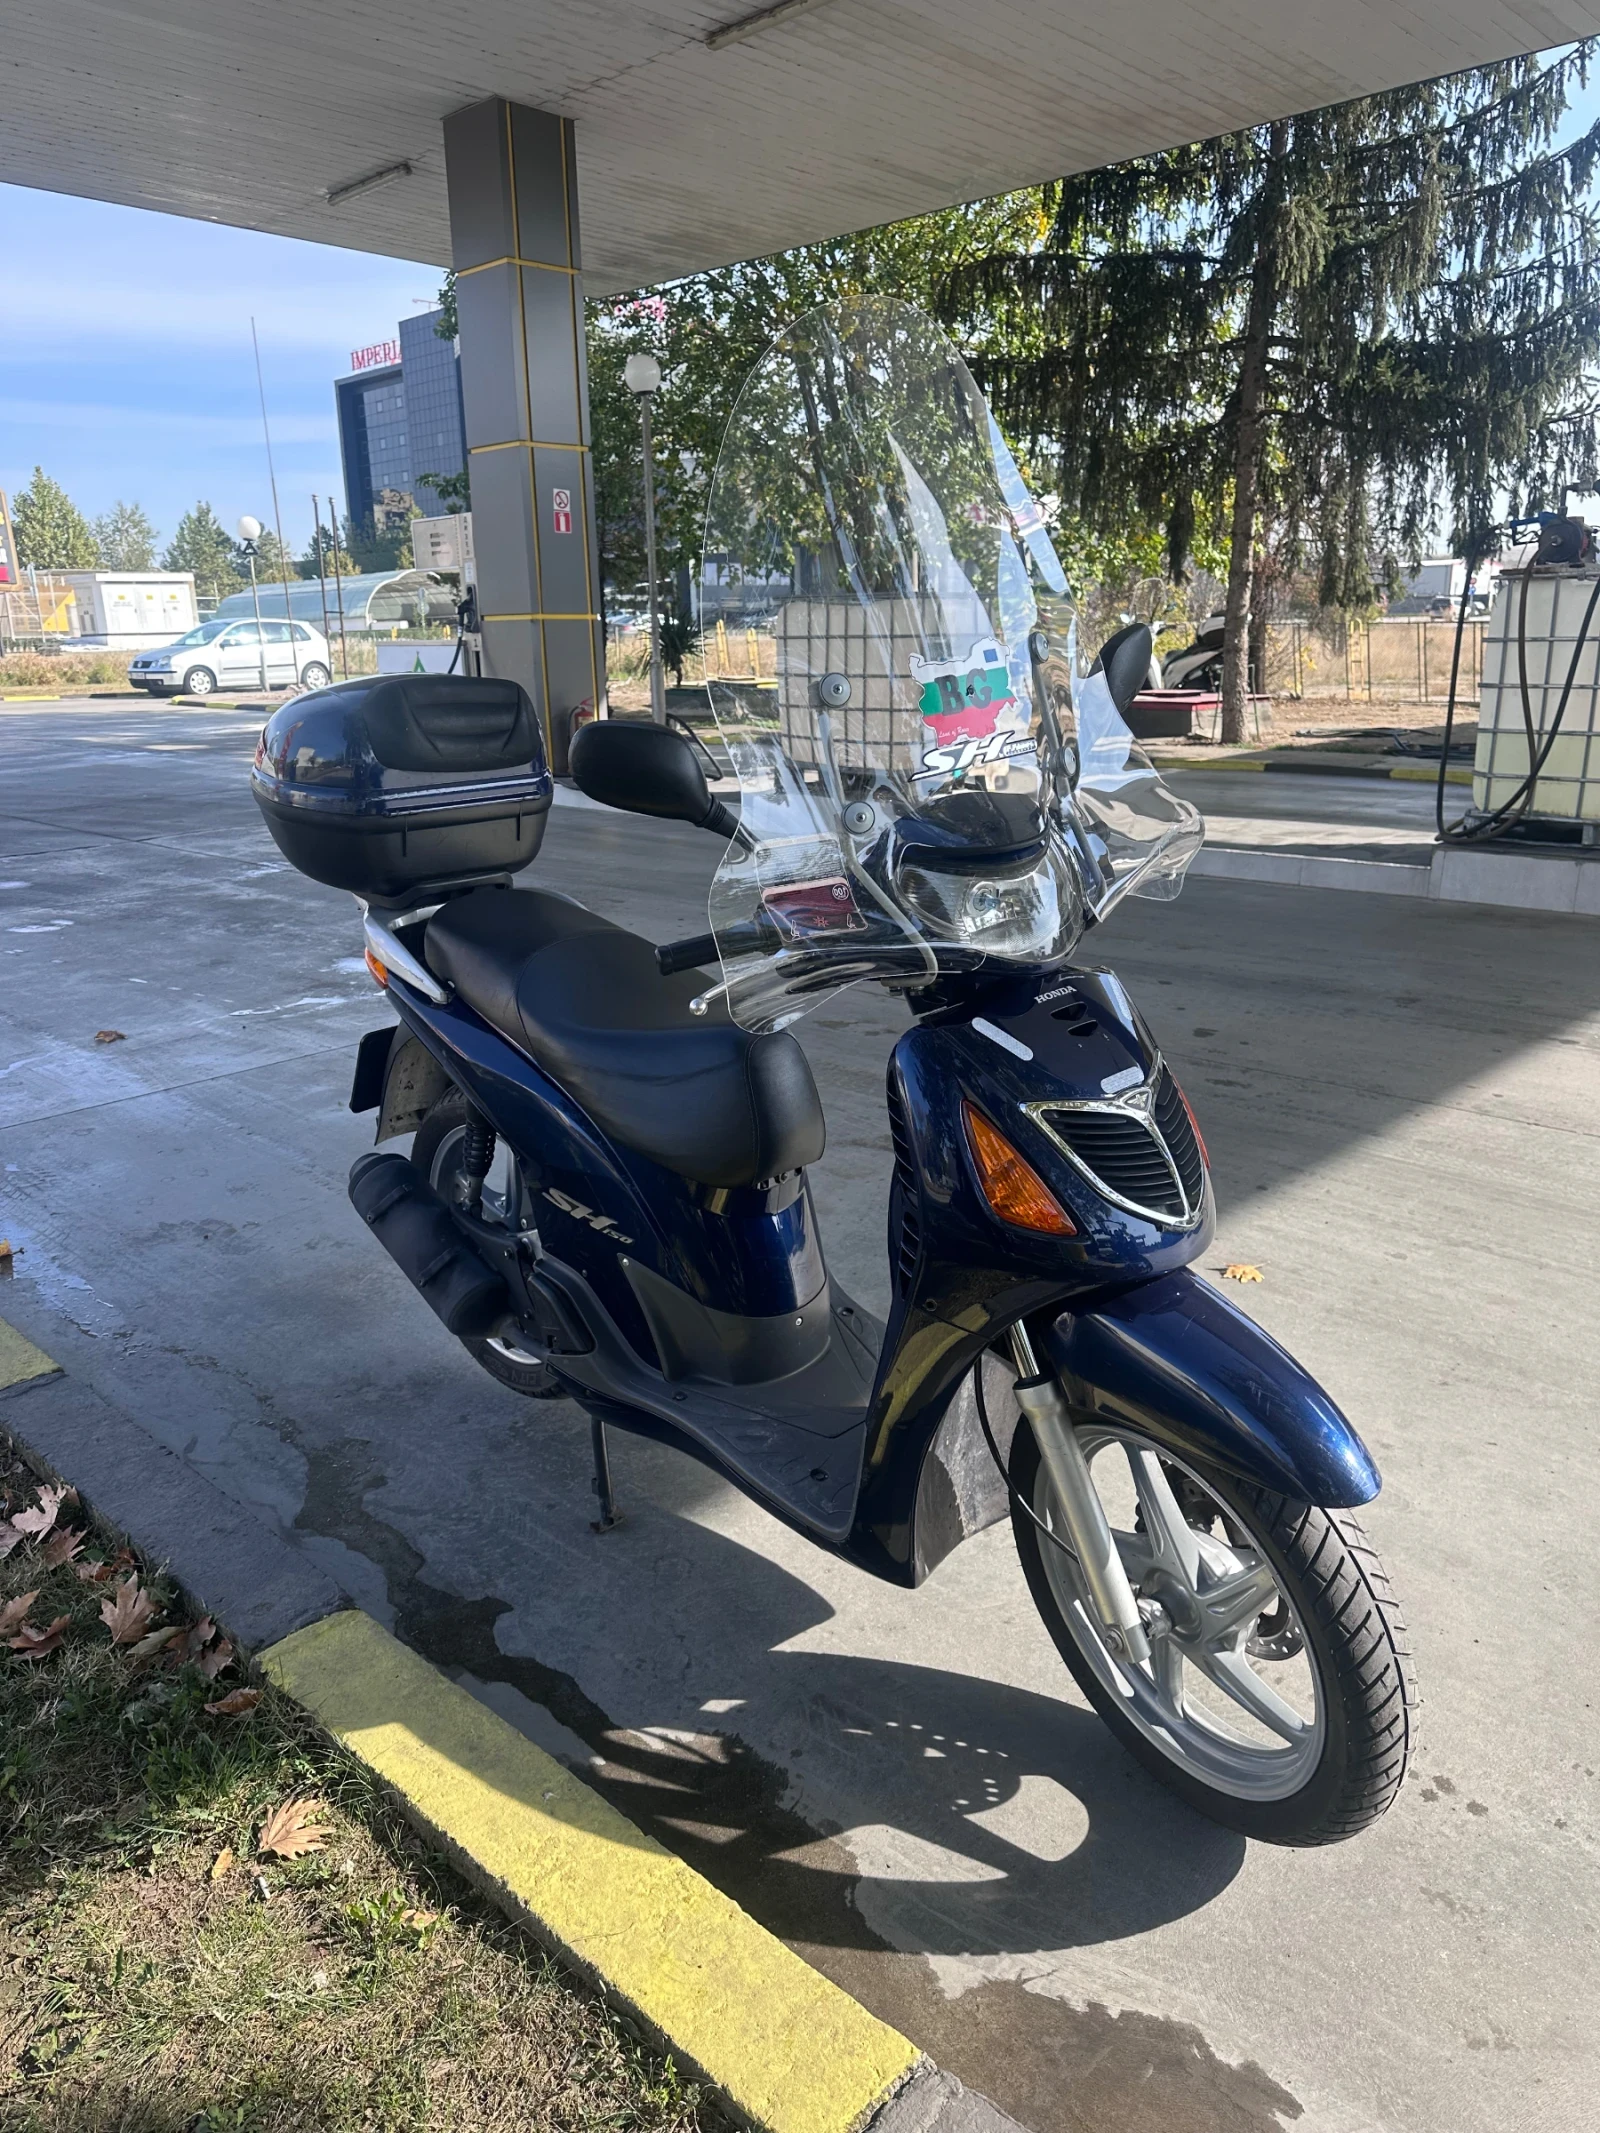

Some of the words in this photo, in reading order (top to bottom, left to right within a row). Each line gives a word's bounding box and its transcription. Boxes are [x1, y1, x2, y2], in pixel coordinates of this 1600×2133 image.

[934, 668, 992, 716] BG
[908, 731, 1015, 783] SH
[1034, 985, 1077, 1003] HONDA
